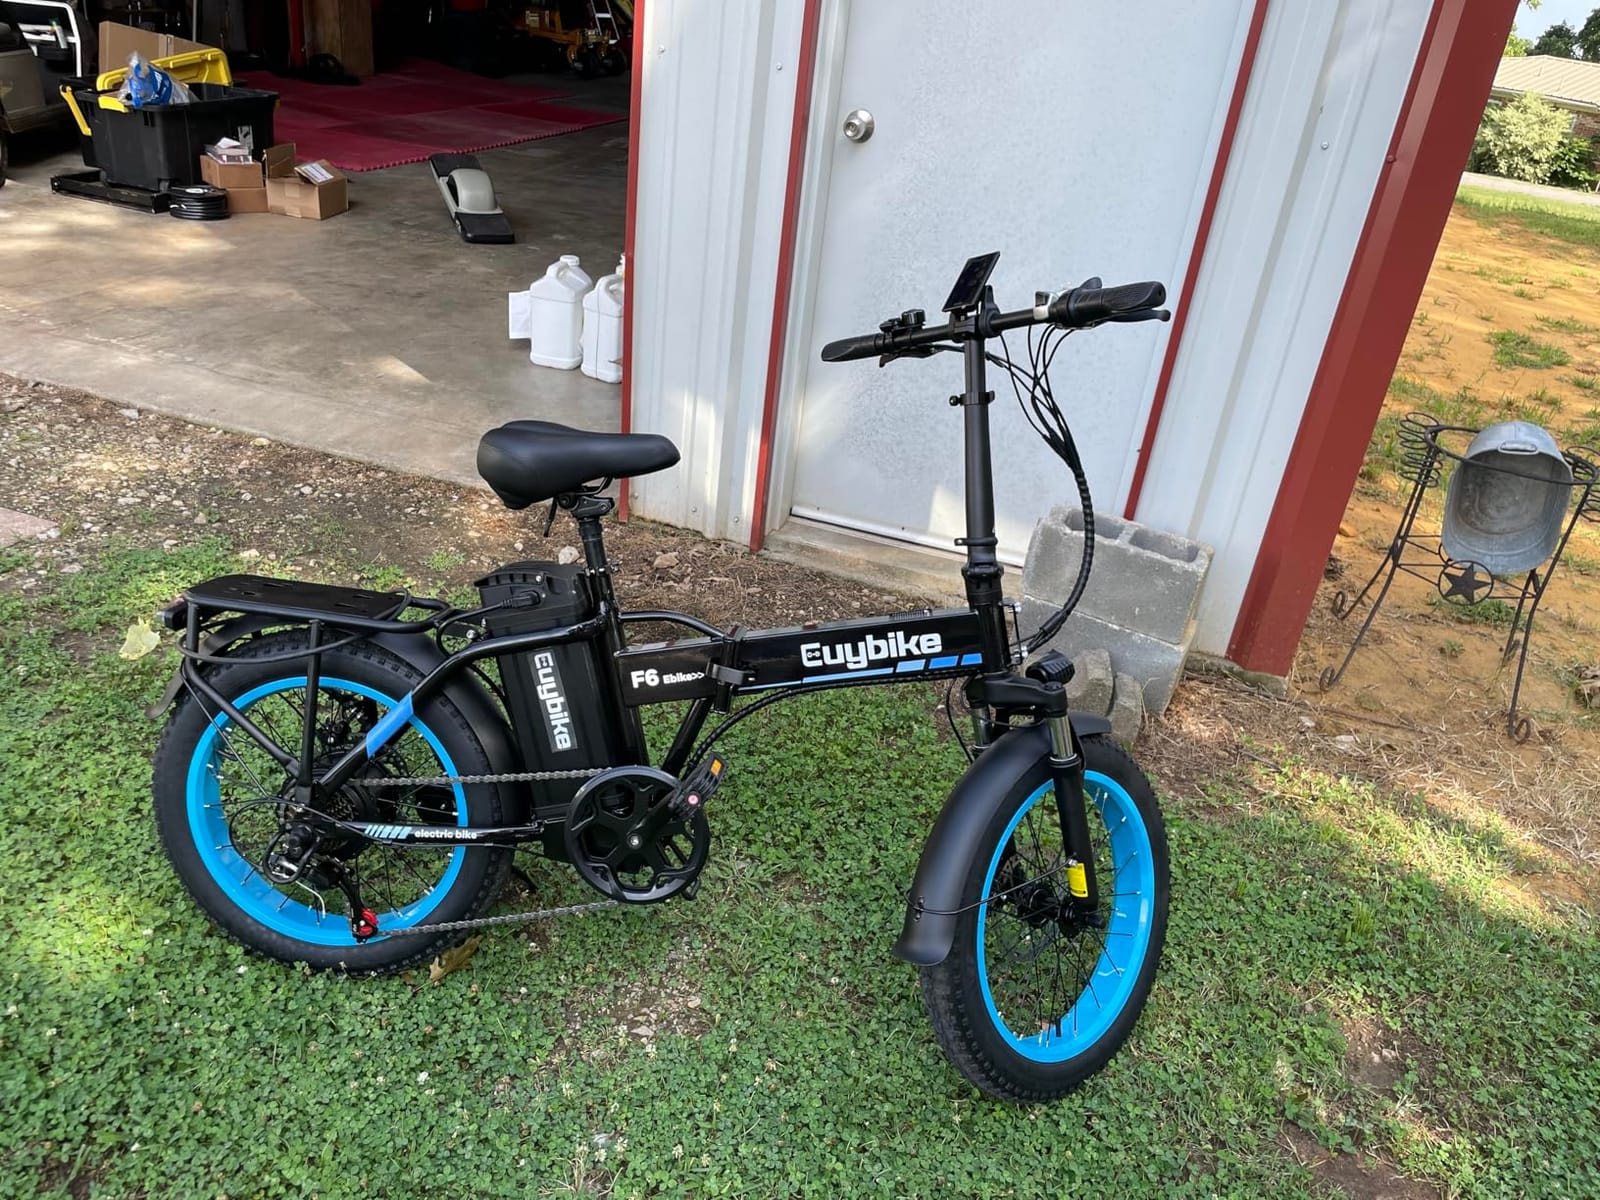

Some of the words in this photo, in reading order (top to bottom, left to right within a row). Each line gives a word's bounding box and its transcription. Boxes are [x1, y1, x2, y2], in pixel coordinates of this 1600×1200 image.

[800, 631, 943, 670] Euybike
[630, 668, 660, 689] F6
[534, 652, 572, 750] Euybike
[414, 828, 453, 840] electric
[455, 829, 478, 840] bike
